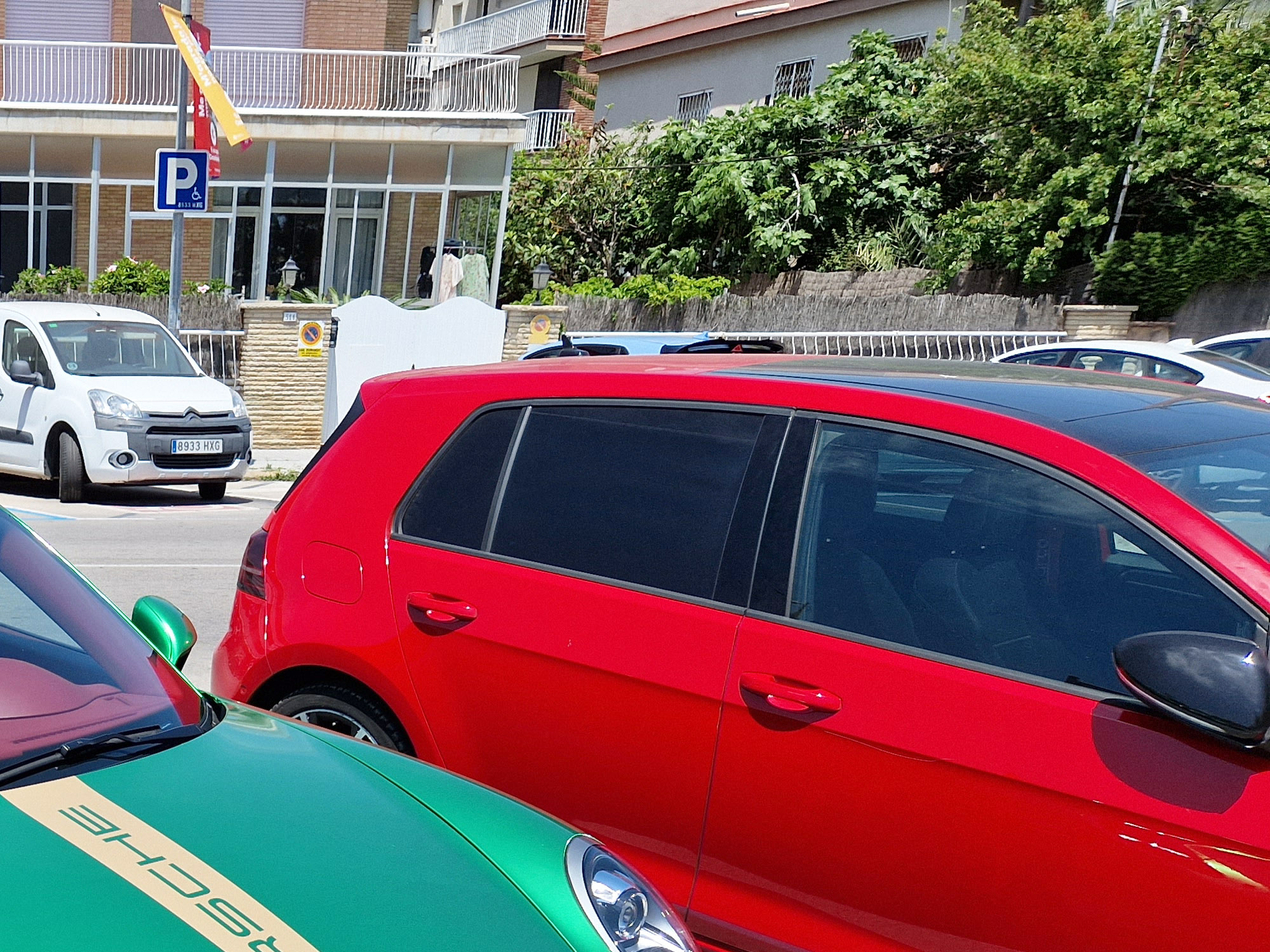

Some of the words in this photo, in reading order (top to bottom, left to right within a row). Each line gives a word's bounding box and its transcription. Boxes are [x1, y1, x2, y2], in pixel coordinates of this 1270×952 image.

[166, 157, 198, 205] P
[177, 441, 201, 451] 8933
[203, 441, 220, 451] HXG
